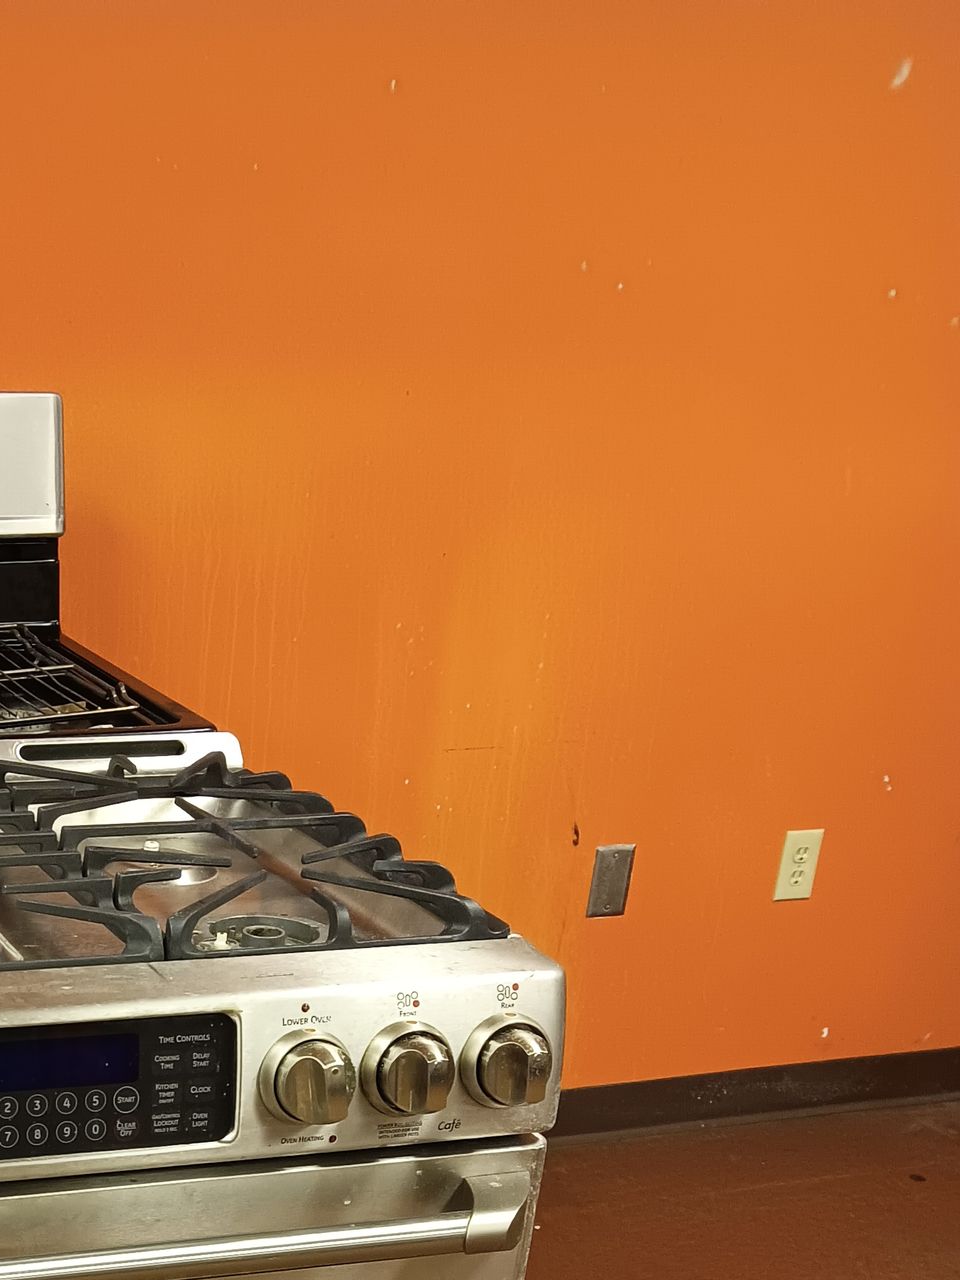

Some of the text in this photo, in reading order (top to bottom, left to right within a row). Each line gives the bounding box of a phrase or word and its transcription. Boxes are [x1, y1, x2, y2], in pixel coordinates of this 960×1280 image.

[282, 1017, 308, 1026] LOWER
[176, 1034, 210, 1042] CONTROLS
[192, 1052, 210, 1060] DELAY
[4, 1102, 11, 1113] 2
[33, 1100, 41, 1111] 3
[63, 1097, 71, 1109] 4
[92, 1095, 100, 1106] 5
[117, 1096, 136, 1104] START
[117, 1121, 137, 1131] CLEAR
[192, 1120, 208, 1128] LIGHT
[437, 1118, 462, 1132] Café
[4, 1131, 12, 1142] 7
[34, 1129, 42, 1140] 8
[63, 1126, 71, 1137] 9
[92, 1124, 100, 1135] 0
[298, 1135, 325, 1143] HEATING
